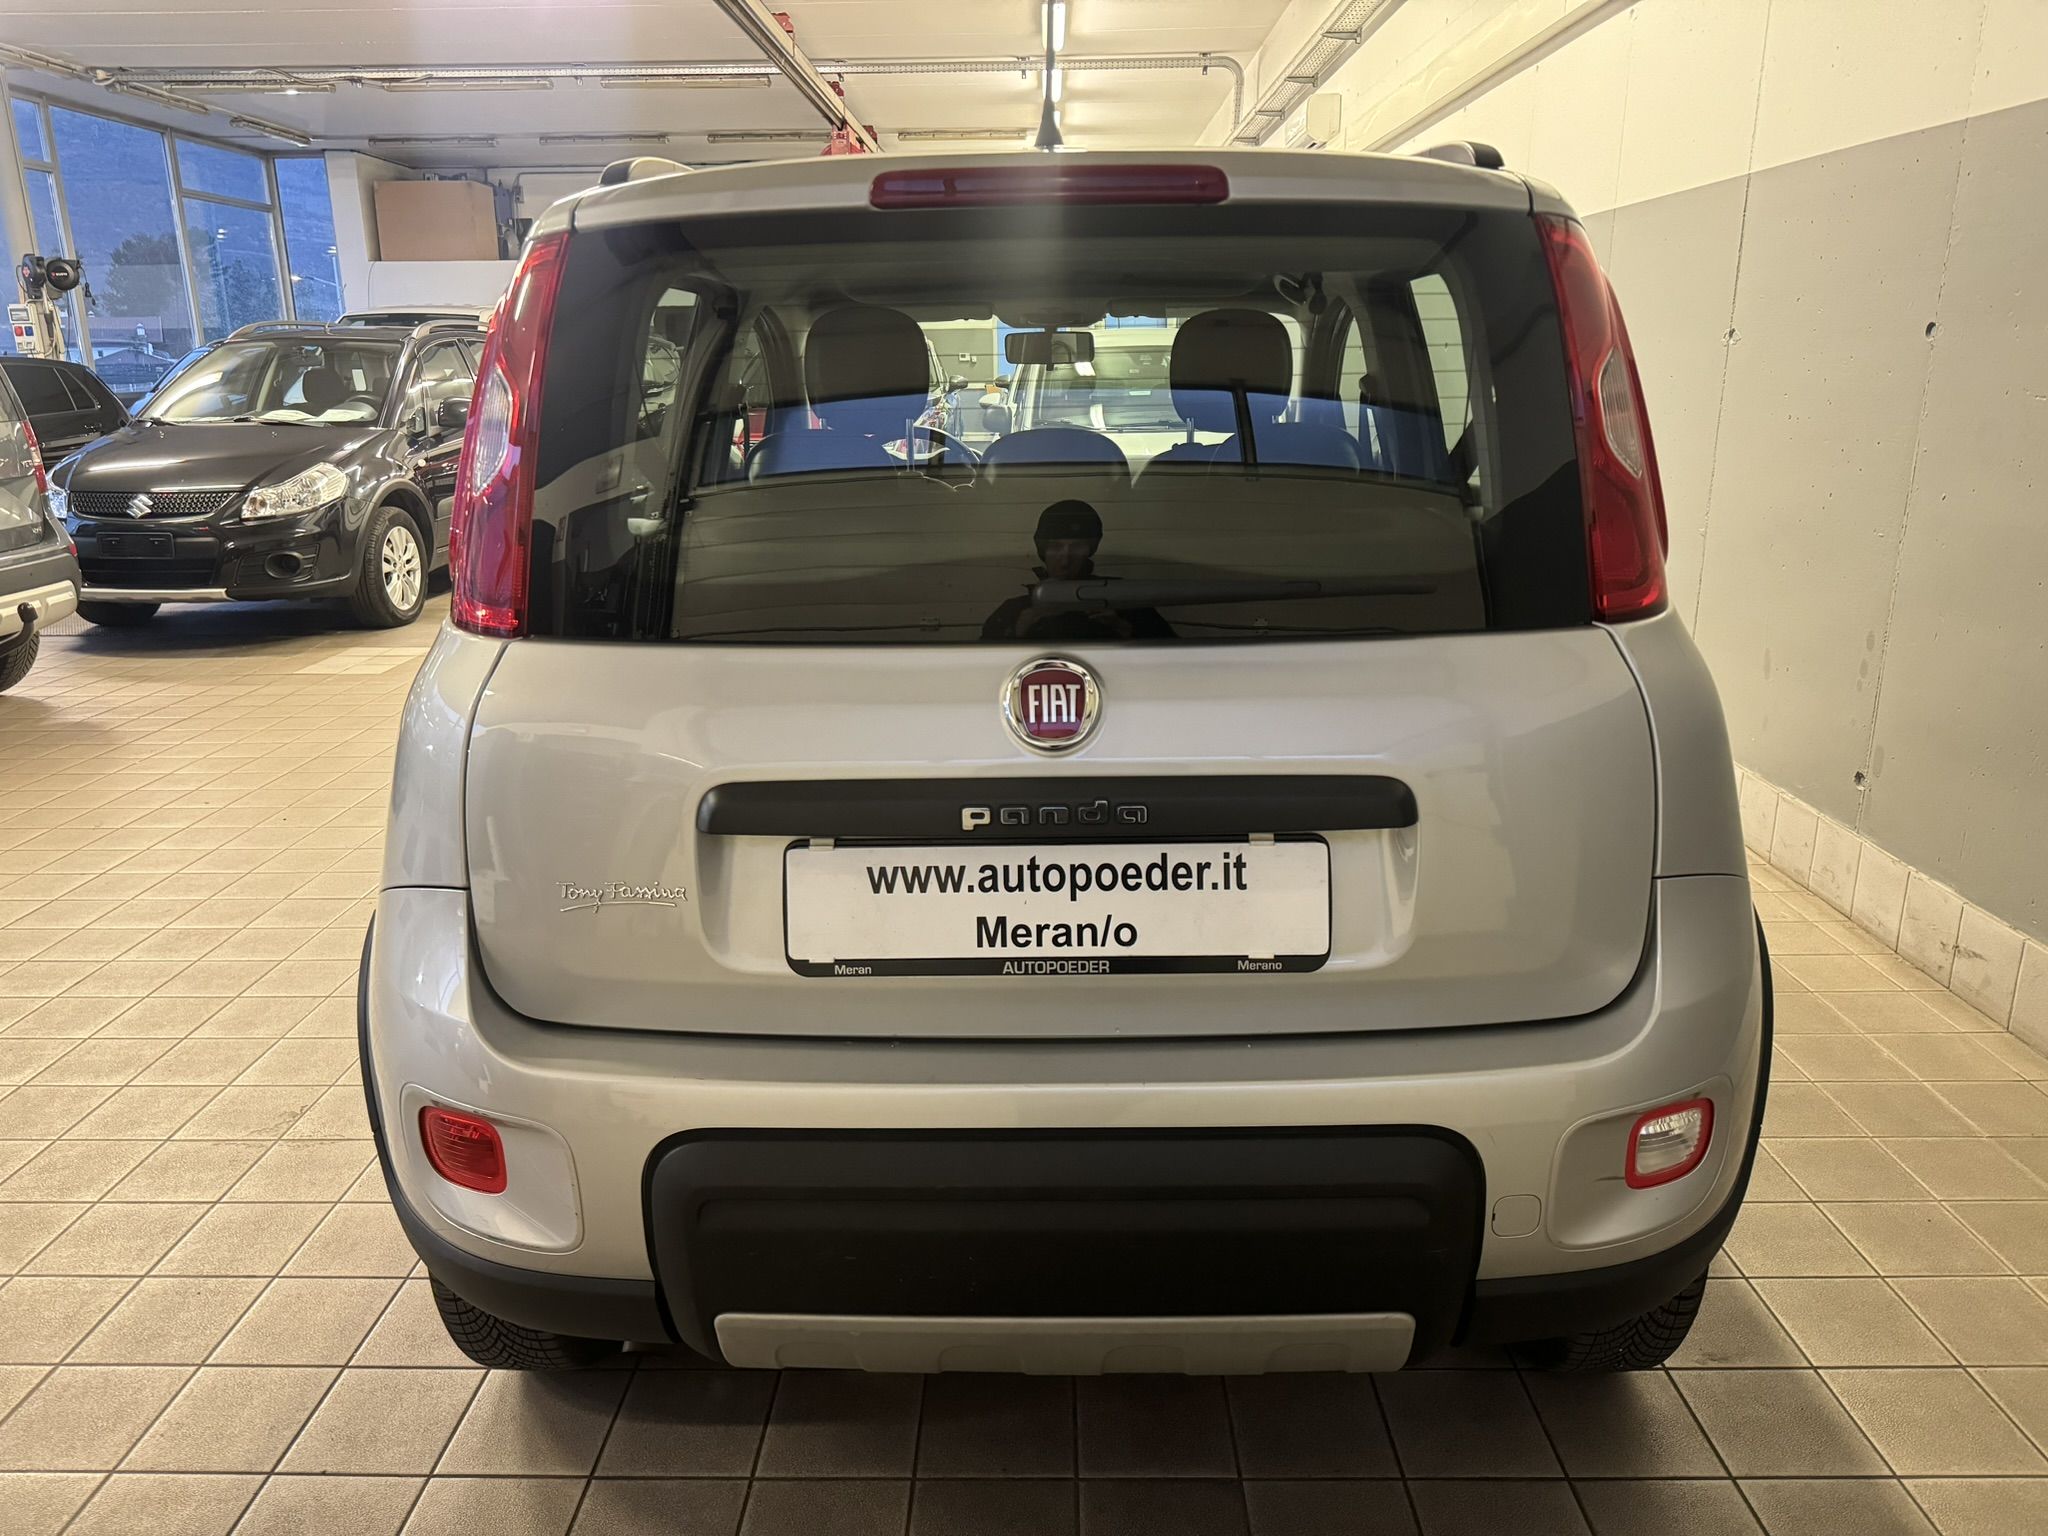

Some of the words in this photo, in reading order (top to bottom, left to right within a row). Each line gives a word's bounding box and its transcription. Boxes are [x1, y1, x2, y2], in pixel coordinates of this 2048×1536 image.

[1027, 684, 1081, 724] FIAT
[961, 800, 1149, 831] panda
[866, 851, 1248, 902] www.autopoeder.it
[555, 881, 604, 913] Tony
[976, 914, 1138, 948] Meran/o
[834, 964, 872, 975] Meran
[1002, 960, 1110, 974] AUTOPOEDER
[1237, 960, 1283, 971] Merano
